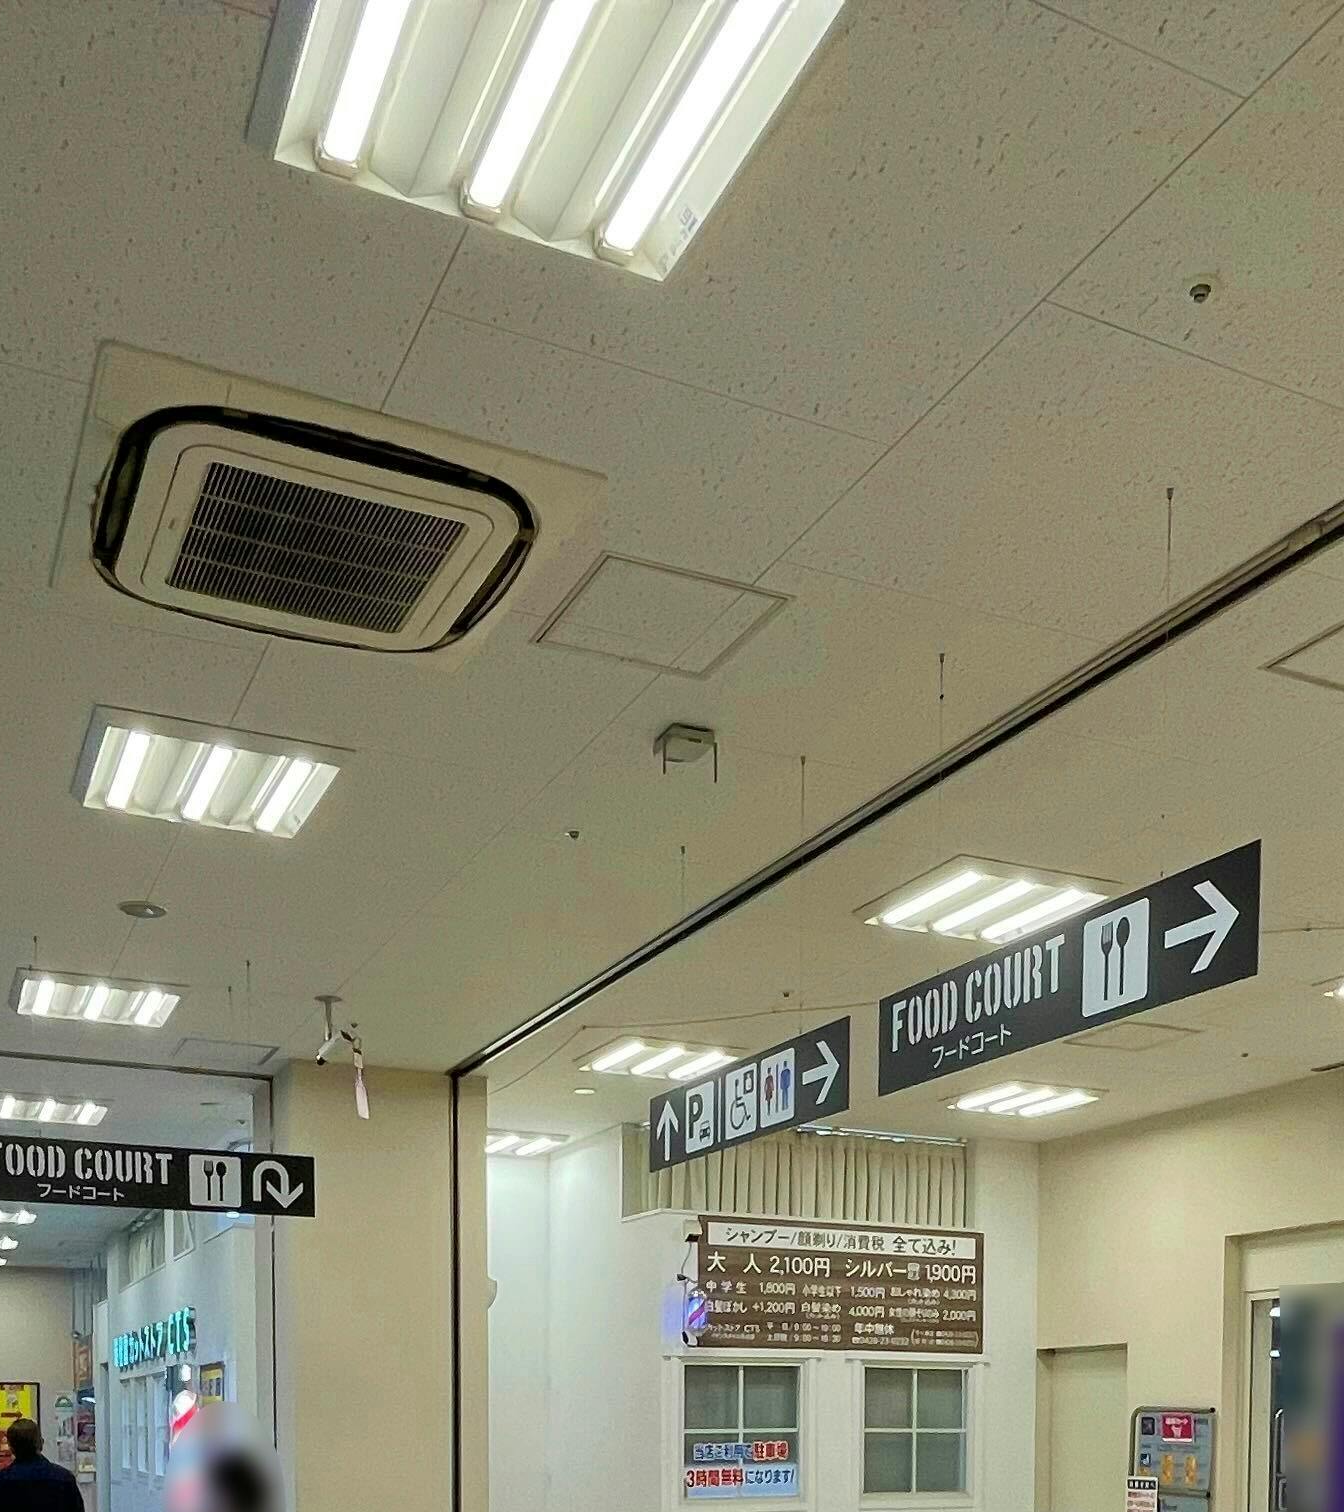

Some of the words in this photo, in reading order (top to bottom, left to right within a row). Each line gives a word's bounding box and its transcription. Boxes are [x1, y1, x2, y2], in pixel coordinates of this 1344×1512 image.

[892, 980, 957, 1053] FOOD
[965, 934, 1065, 1023] COURT
[932, 1024, 1011, 1068] フードコート
[74, 1147, 173, 1185] COURT
[37, 1183, 125, 1201] フードコート
[769, 1255, 831, 1278] 2,100円
[925, 1264, 976, 1285] 1,900円
